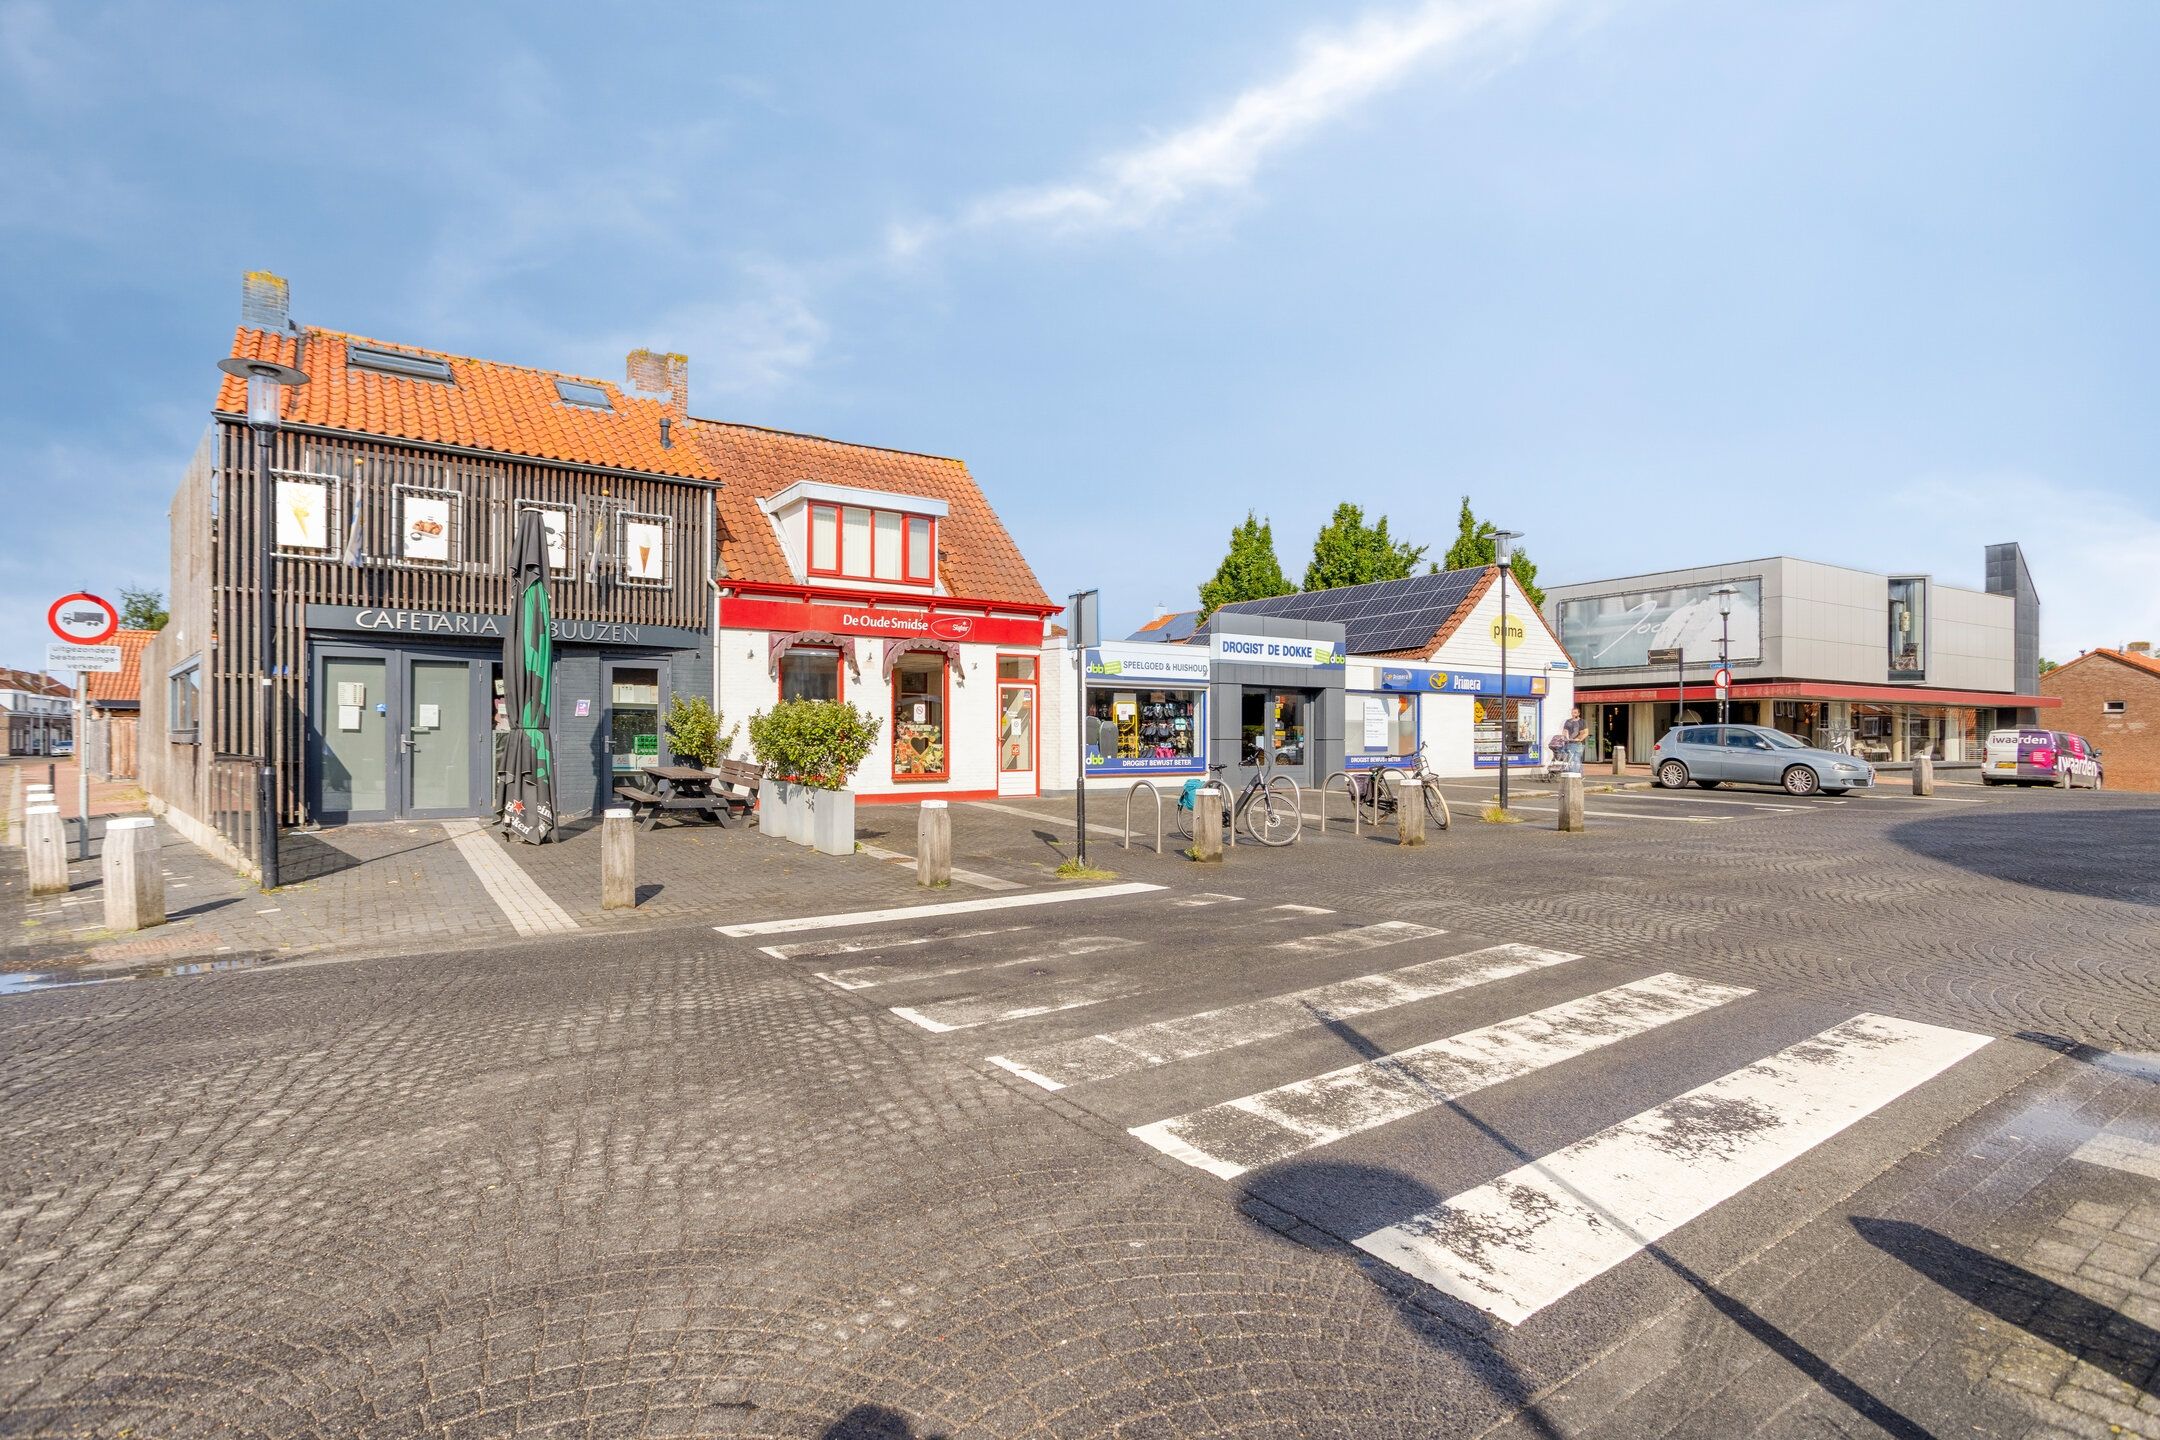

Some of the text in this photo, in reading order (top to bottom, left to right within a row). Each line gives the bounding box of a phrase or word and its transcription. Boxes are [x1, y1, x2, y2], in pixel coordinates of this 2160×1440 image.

[355, 610, 500, 635] CAFETARIA
[843, 614, 859, 625] De
[860, 616, 890, 628] Oude
[891, 617, 928, 631] Smidse
[1222, 641, 1264, 654] DROGIST
[1268, 644, 1280, 656] DE
[1283, 645, 1312, 658] DOKKE
[1330, 651, 1345, 664] dbb
[1086, 661, 1104, 674] dbb
[1123, 661, 1164, 671] SPEELGOED
[1165, 663, 1171, 671] &
[1173, 664, 1208, 673] HUISHOUD
[1453, 675, 1481, 690] Primera
[1992, 735, 2047, 744] iwaarden
[1086, 752, 1104, 765] dbb
